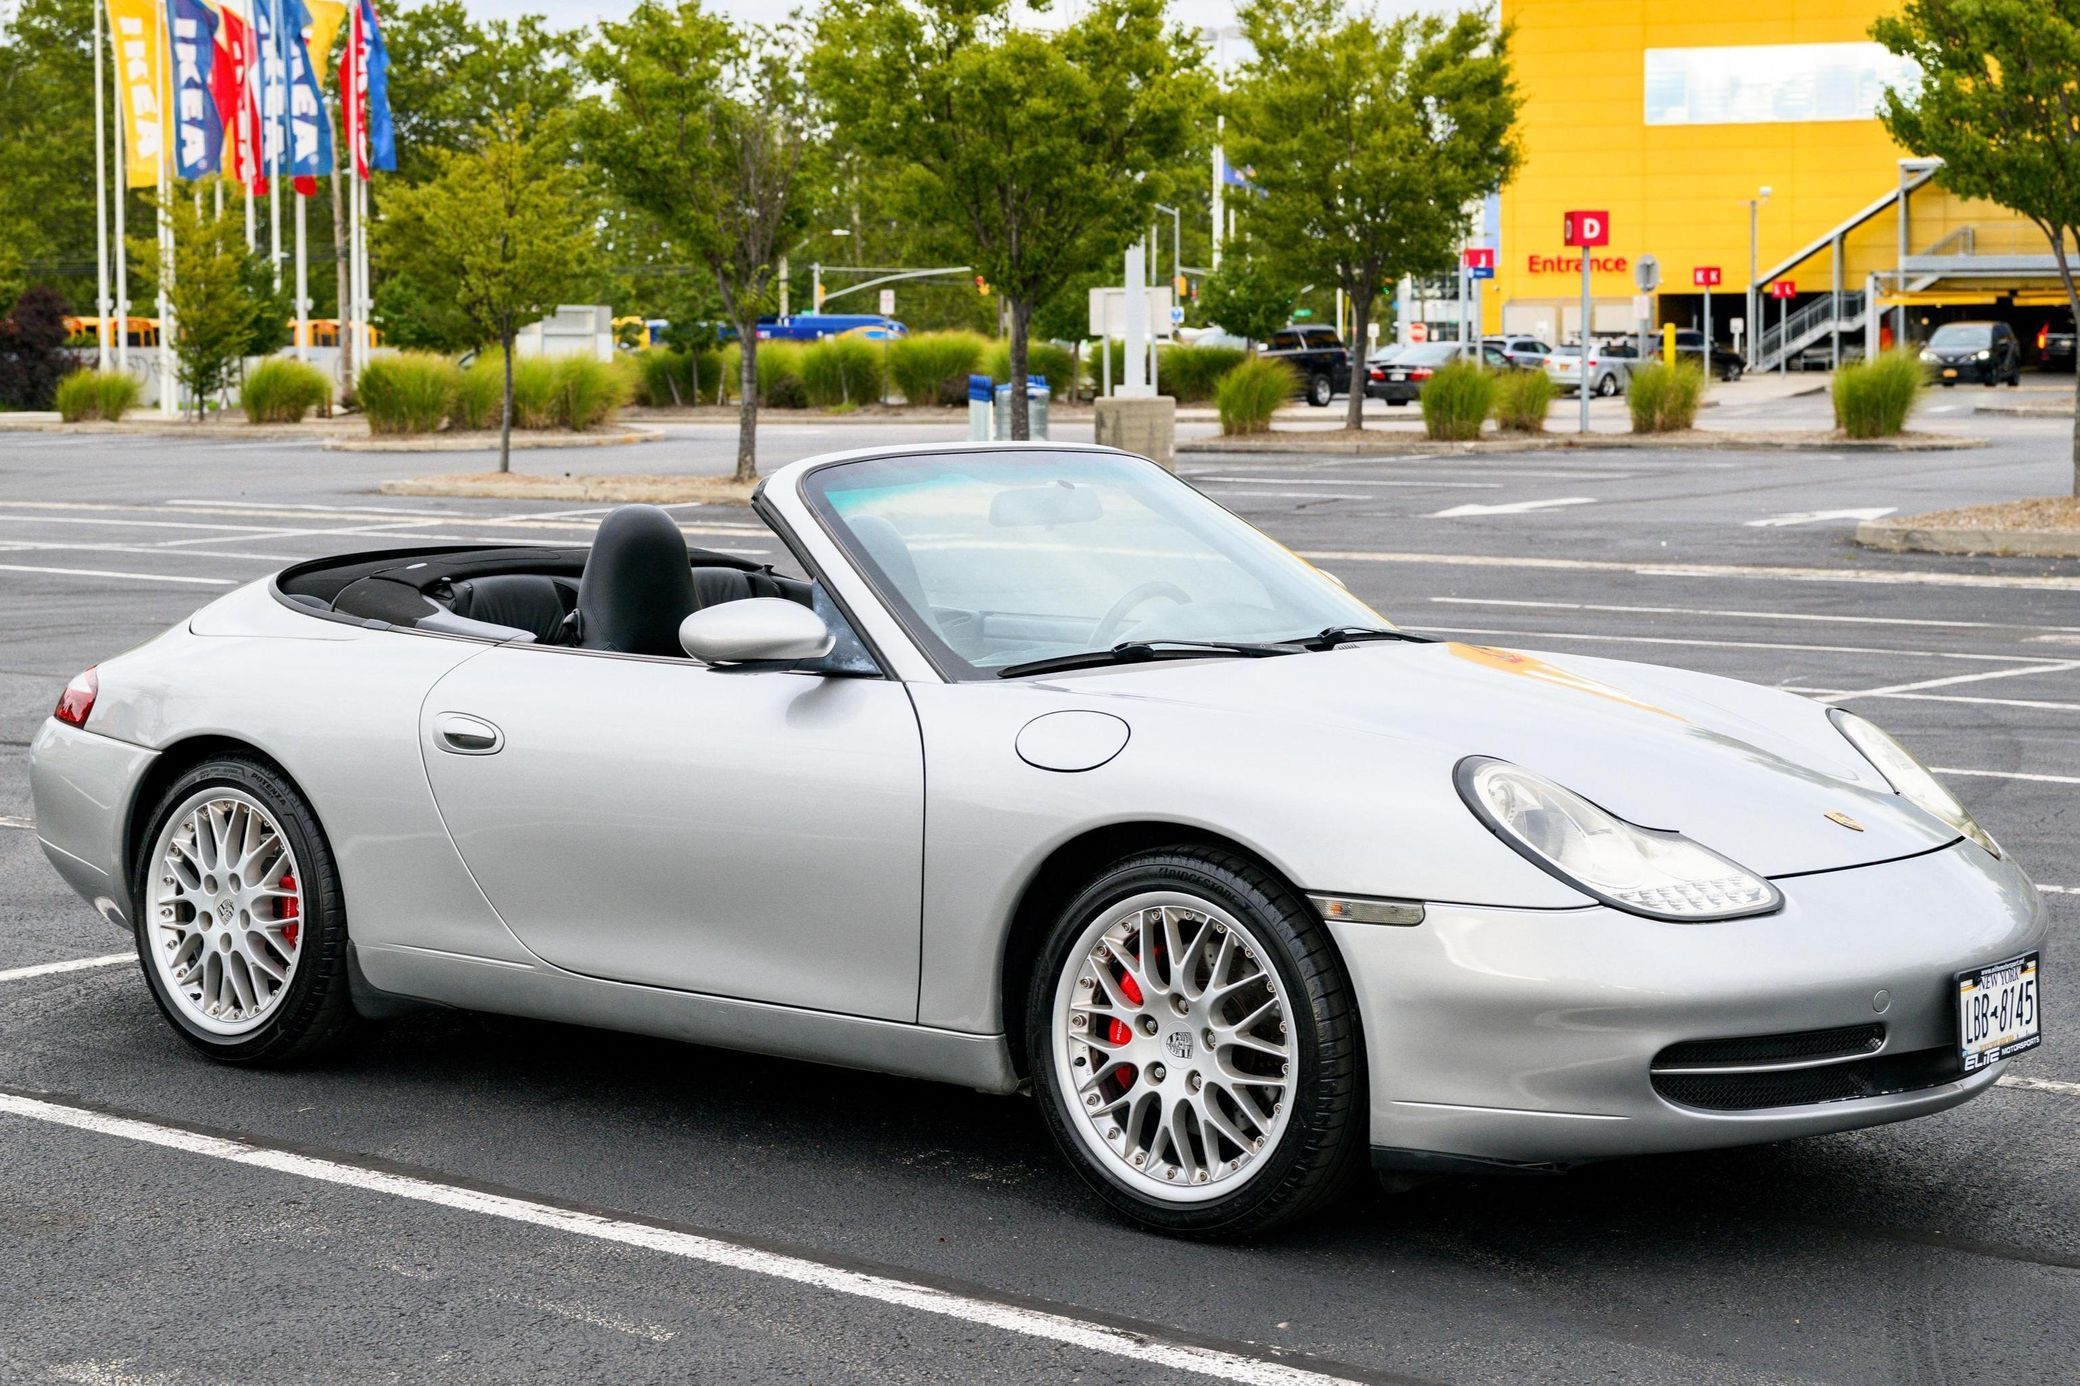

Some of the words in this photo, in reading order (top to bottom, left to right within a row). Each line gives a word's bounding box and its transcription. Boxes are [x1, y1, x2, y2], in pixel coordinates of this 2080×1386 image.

[119, 17, 160, 160] IKEA
[174, 18, 206, 168] IKEA
[290, 37, 318, 162] KEA
[1583, 218, 1601, 239] D
[1478, 253, 1487, 268] J
[1528, 255, 1628, 273] Entrance
[251, 772, 286, 806] POTENZA
[1979, 972, 1999, 991] NEW
[2000, 965, 2019, 985] YORK
[2001, 1035, 2040, 1056] MOTORSPORTS
